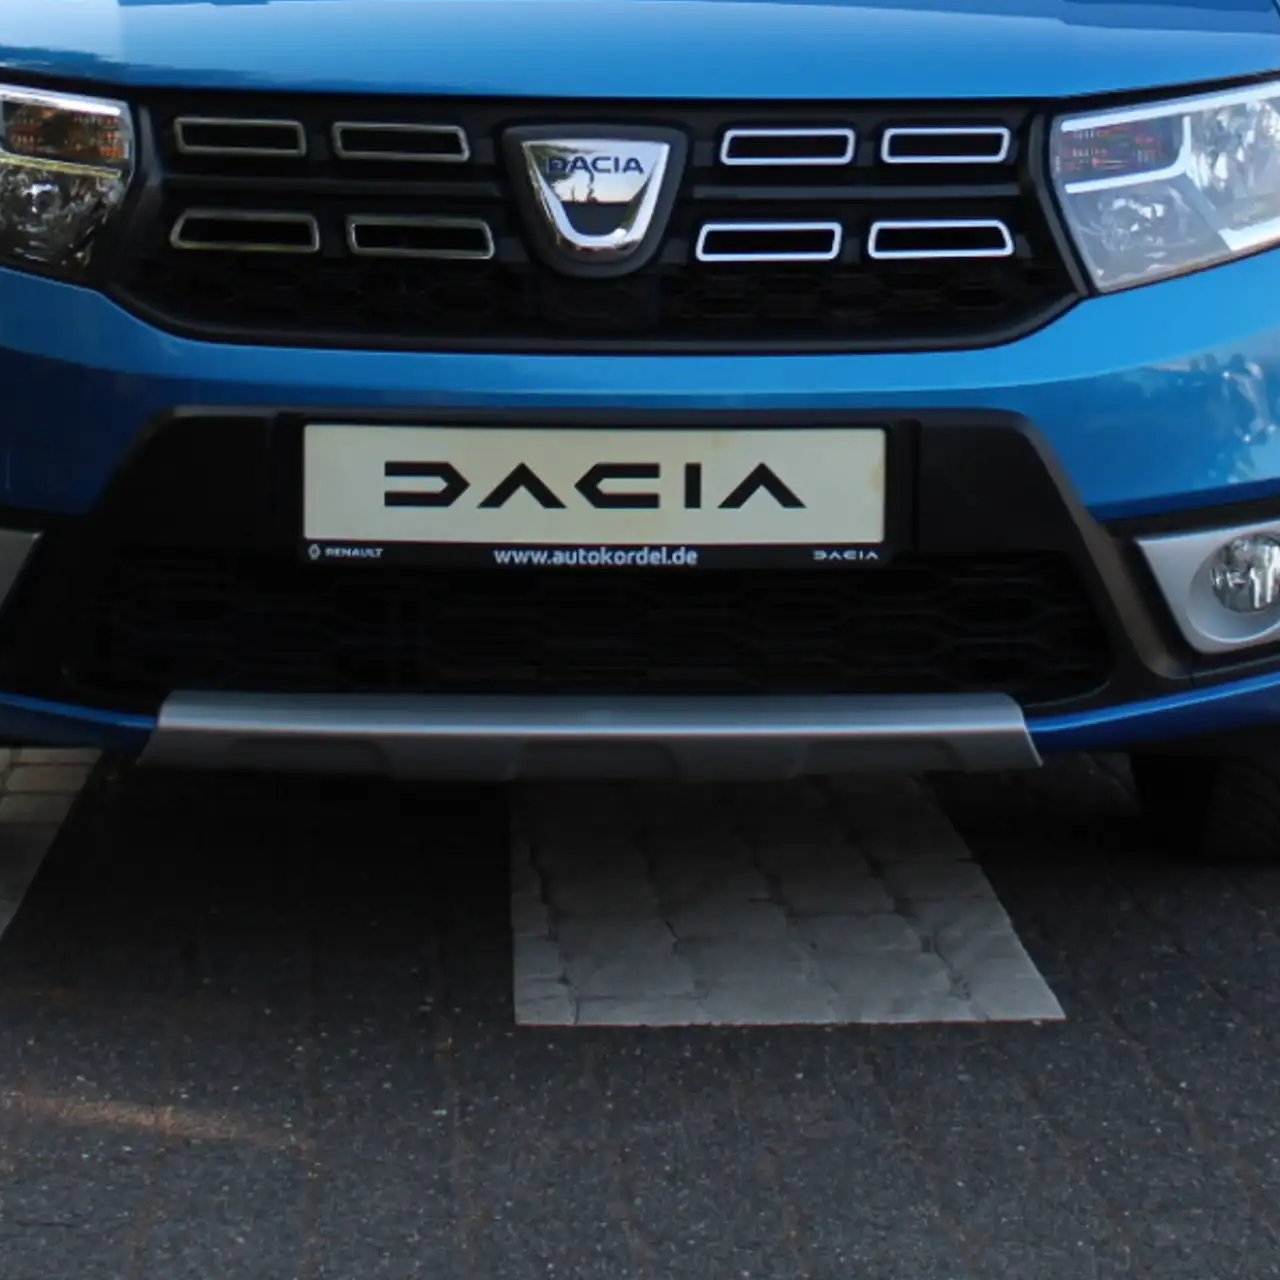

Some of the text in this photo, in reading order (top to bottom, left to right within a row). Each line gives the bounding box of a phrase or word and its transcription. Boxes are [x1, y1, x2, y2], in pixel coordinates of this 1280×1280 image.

[547, 156, 644, 174] DACIA
[384, 461, 806, 509] DACIA
[324, 547, 384, 558] RENAULT
[493, 546, 698, 566] www.autokordel.de
[813, 549, 879, 561] DACIA
